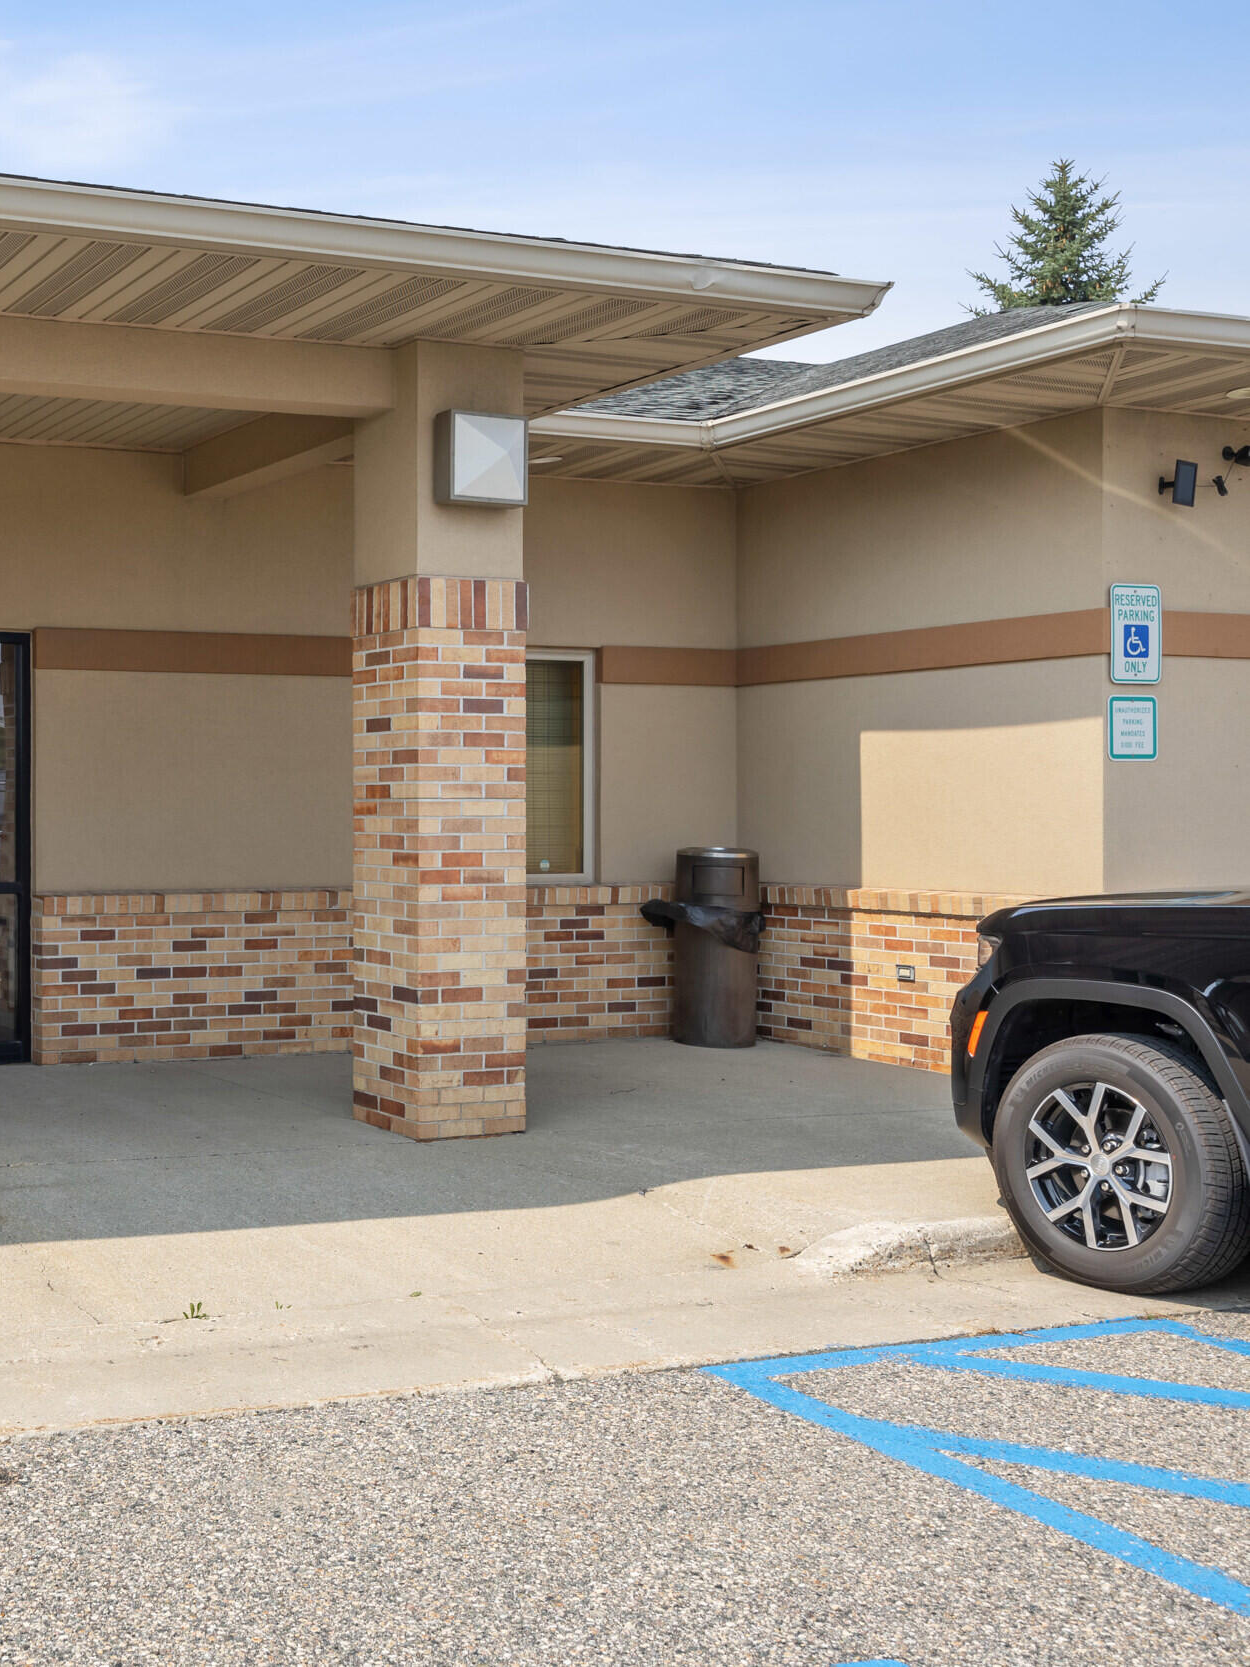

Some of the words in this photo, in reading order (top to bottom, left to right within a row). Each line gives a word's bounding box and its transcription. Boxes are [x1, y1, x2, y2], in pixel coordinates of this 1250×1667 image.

[1114, 593, 1158, 607] RESERVED
[1117, 608, 1155, 622] PARKING
[1124, 661, 1147, 673] ONLY
